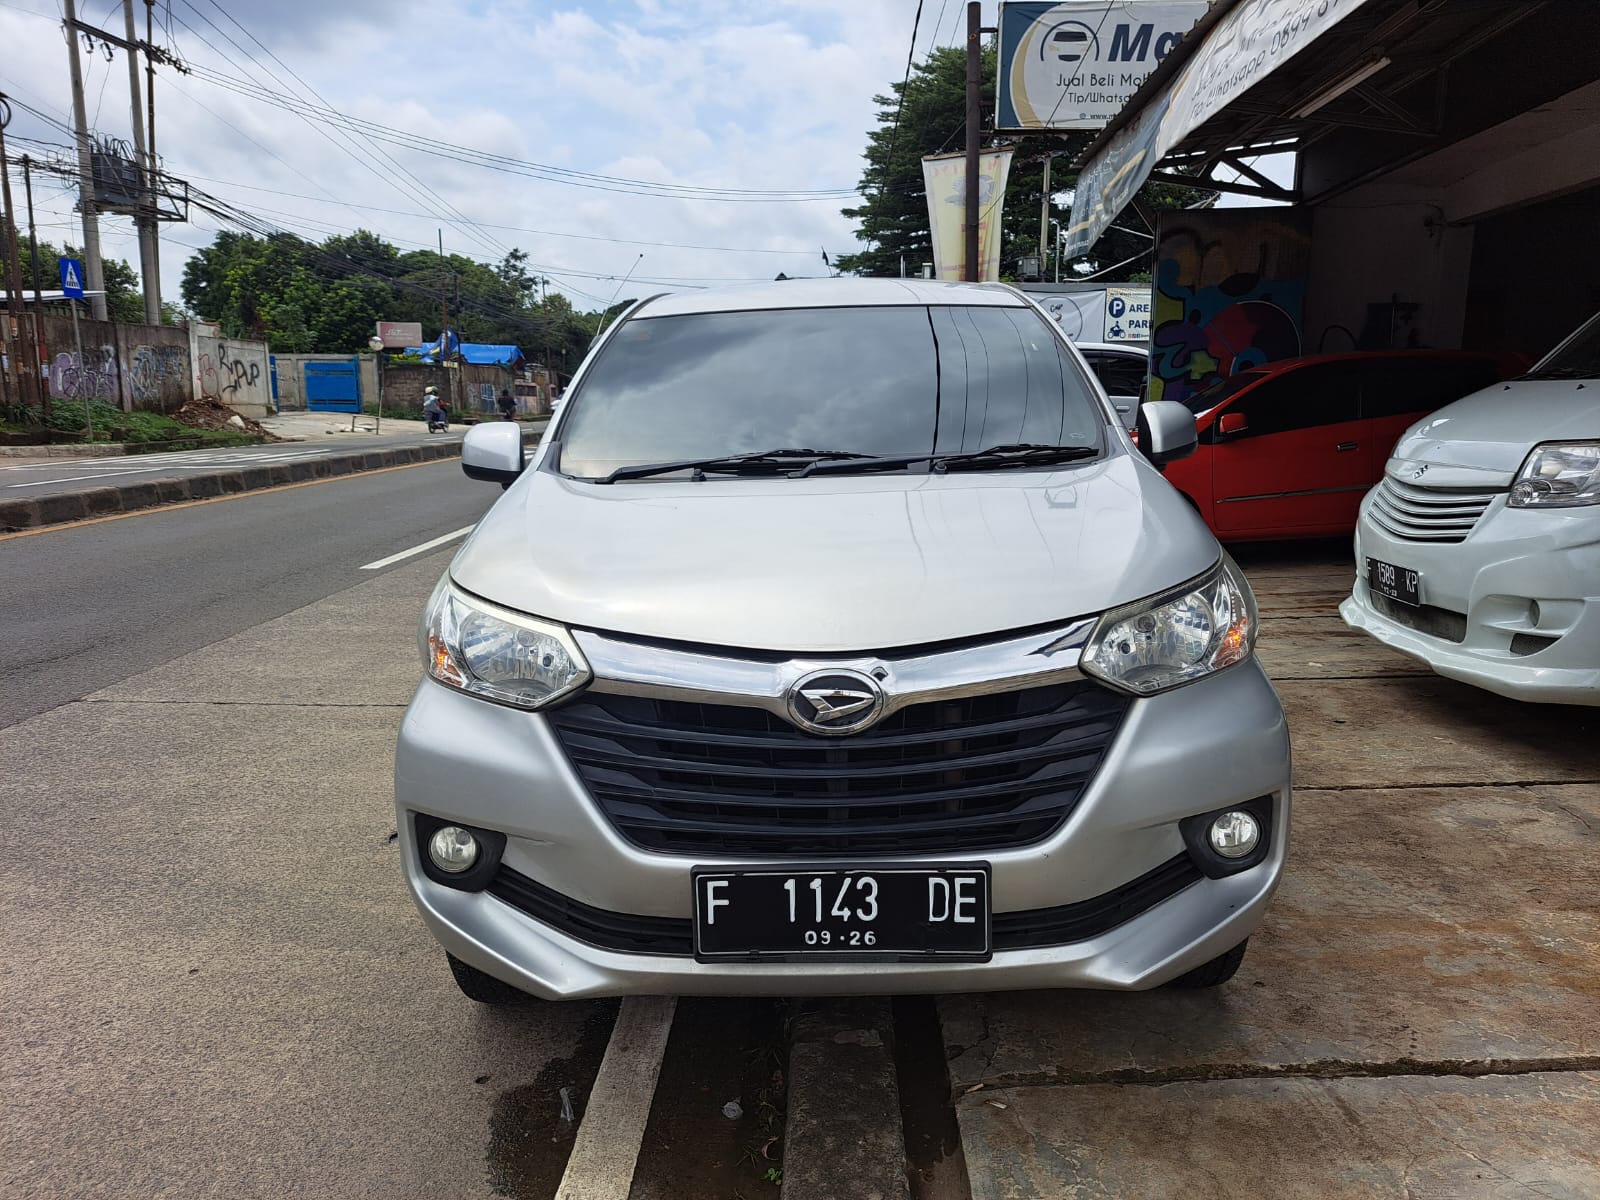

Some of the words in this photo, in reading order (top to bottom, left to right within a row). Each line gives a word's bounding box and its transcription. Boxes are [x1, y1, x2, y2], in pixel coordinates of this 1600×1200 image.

[1056, 74, 1085, 87] Jual
[1090, 74, 1114, 87] Beli
[1377, 562, 1395, 586] 1589
[1405, 570, 1418, 593] KP
[707, 880, 730, 925] F
[783, 876, 879, 923] 1143
[928, 877, 977, 924] DE
